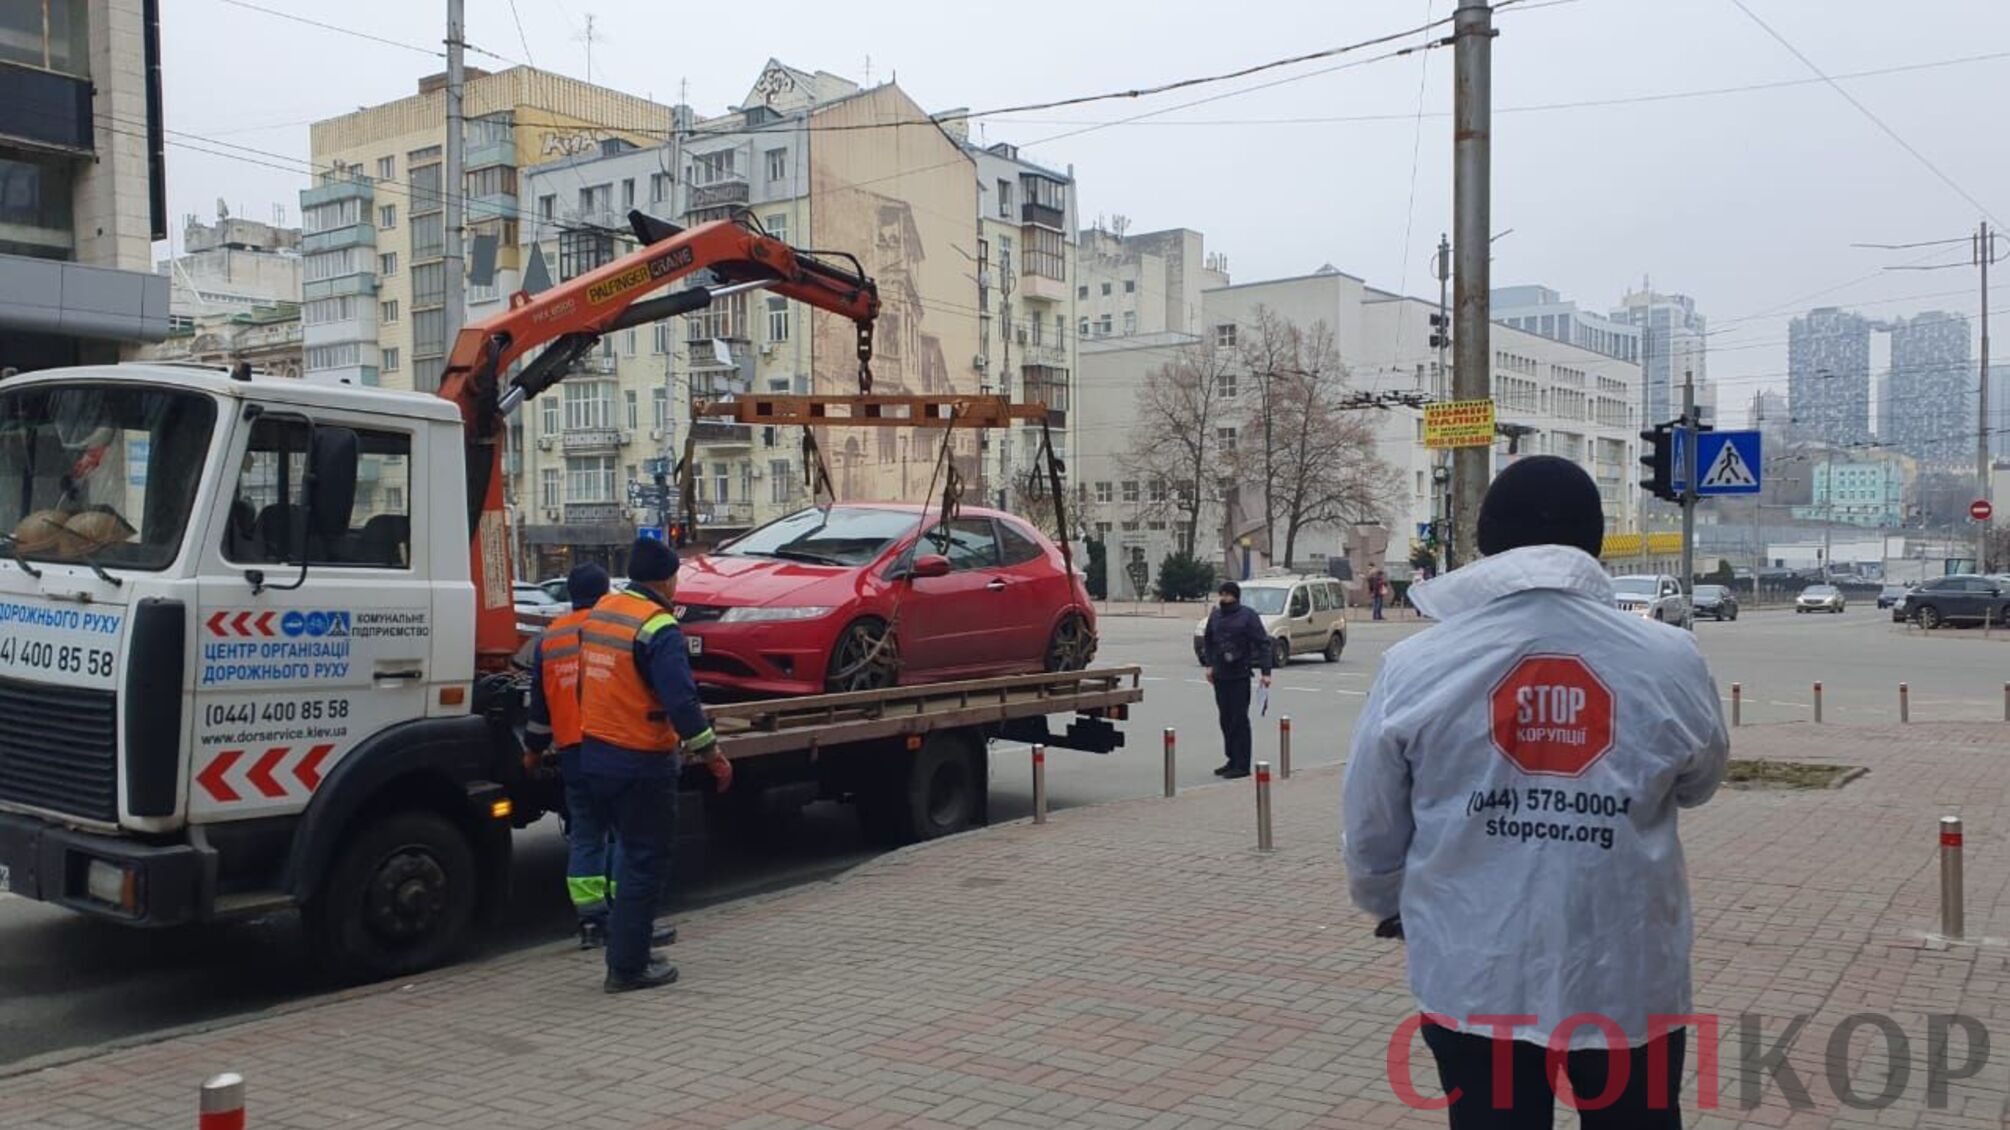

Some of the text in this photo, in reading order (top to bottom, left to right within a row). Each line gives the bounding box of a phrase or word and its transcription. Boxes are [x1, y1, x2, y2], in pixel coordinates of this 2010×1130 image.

[589, 247, 692, 301] PALFINGER CRANE
[0, 603, 120, 634] ДОРОЖНЬОГО РУХУ
[352, 627, 429, 637] ПІДПРИЄМСТВО
[356, 614, 425, 624] КОМУНАЛЬНЕ
[20, 641, 53, 669] 400
[58, 645, 82, 672] 85
[88, 649, 114, 677] 58
[205, 638, 350, 662] ЦЕНТР ОРГАНІЗАЦІЇ
[203, 664, 349, 684] ДОРОЖНЬОГО РУХУ
[206, 700, 349, 727] (044) 400 85 58
[1516, 685, 1586, 724] STOP
[201, 727, 347, 745] www.dorservice.kiev.ua
[1516, 727, 1588, 745] КОРУПЦІЇ
[1466, 788, 1519, 816] (044)
[1486, 816, 1614, 849] stopcor.org
